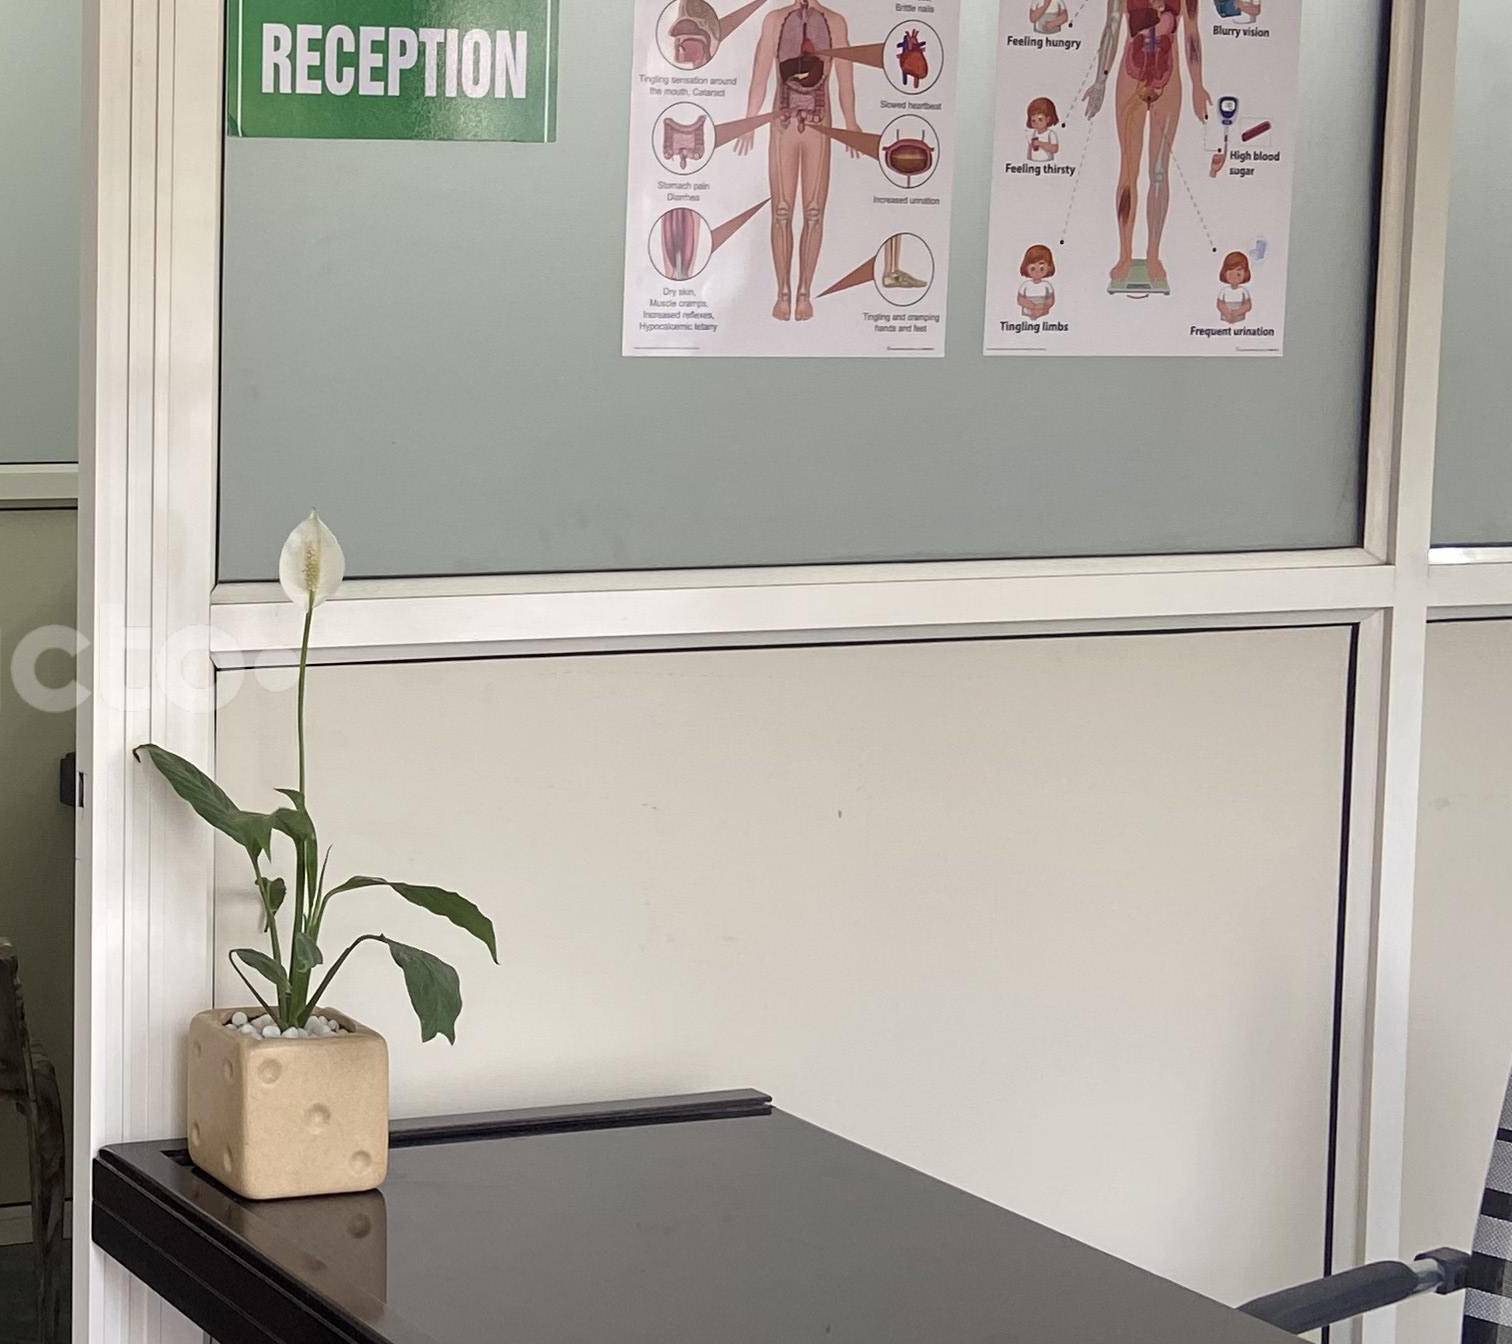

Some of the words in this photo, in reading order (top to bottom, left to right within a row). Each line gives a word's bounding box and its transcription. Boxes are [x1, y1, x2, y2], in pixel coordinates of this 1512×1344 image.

[1213, 25, 1241, 38] Blurry
[1243, 27, 1270, 37] vision
[1007, 36, 1043, 49] Feeling
[1045, 37, 1081, 50] hungry
[262, 23, 527, 99] RECEPTION
[1230, 150, 1252, 163] High
[1253, 151, 1280, 161] blood
[1005, 163, 1041, 176] Feeling
[1043, 163, 1075, 177] thirsty
[1229, 167, 1255, 177] sugar
[1000, 321, 1040, 333] Tingling
[1042, 321, 1069, 331] limbs
[1190, 326, 1232, 338] Frequent
[1233, 326, 1274, 336] urination
